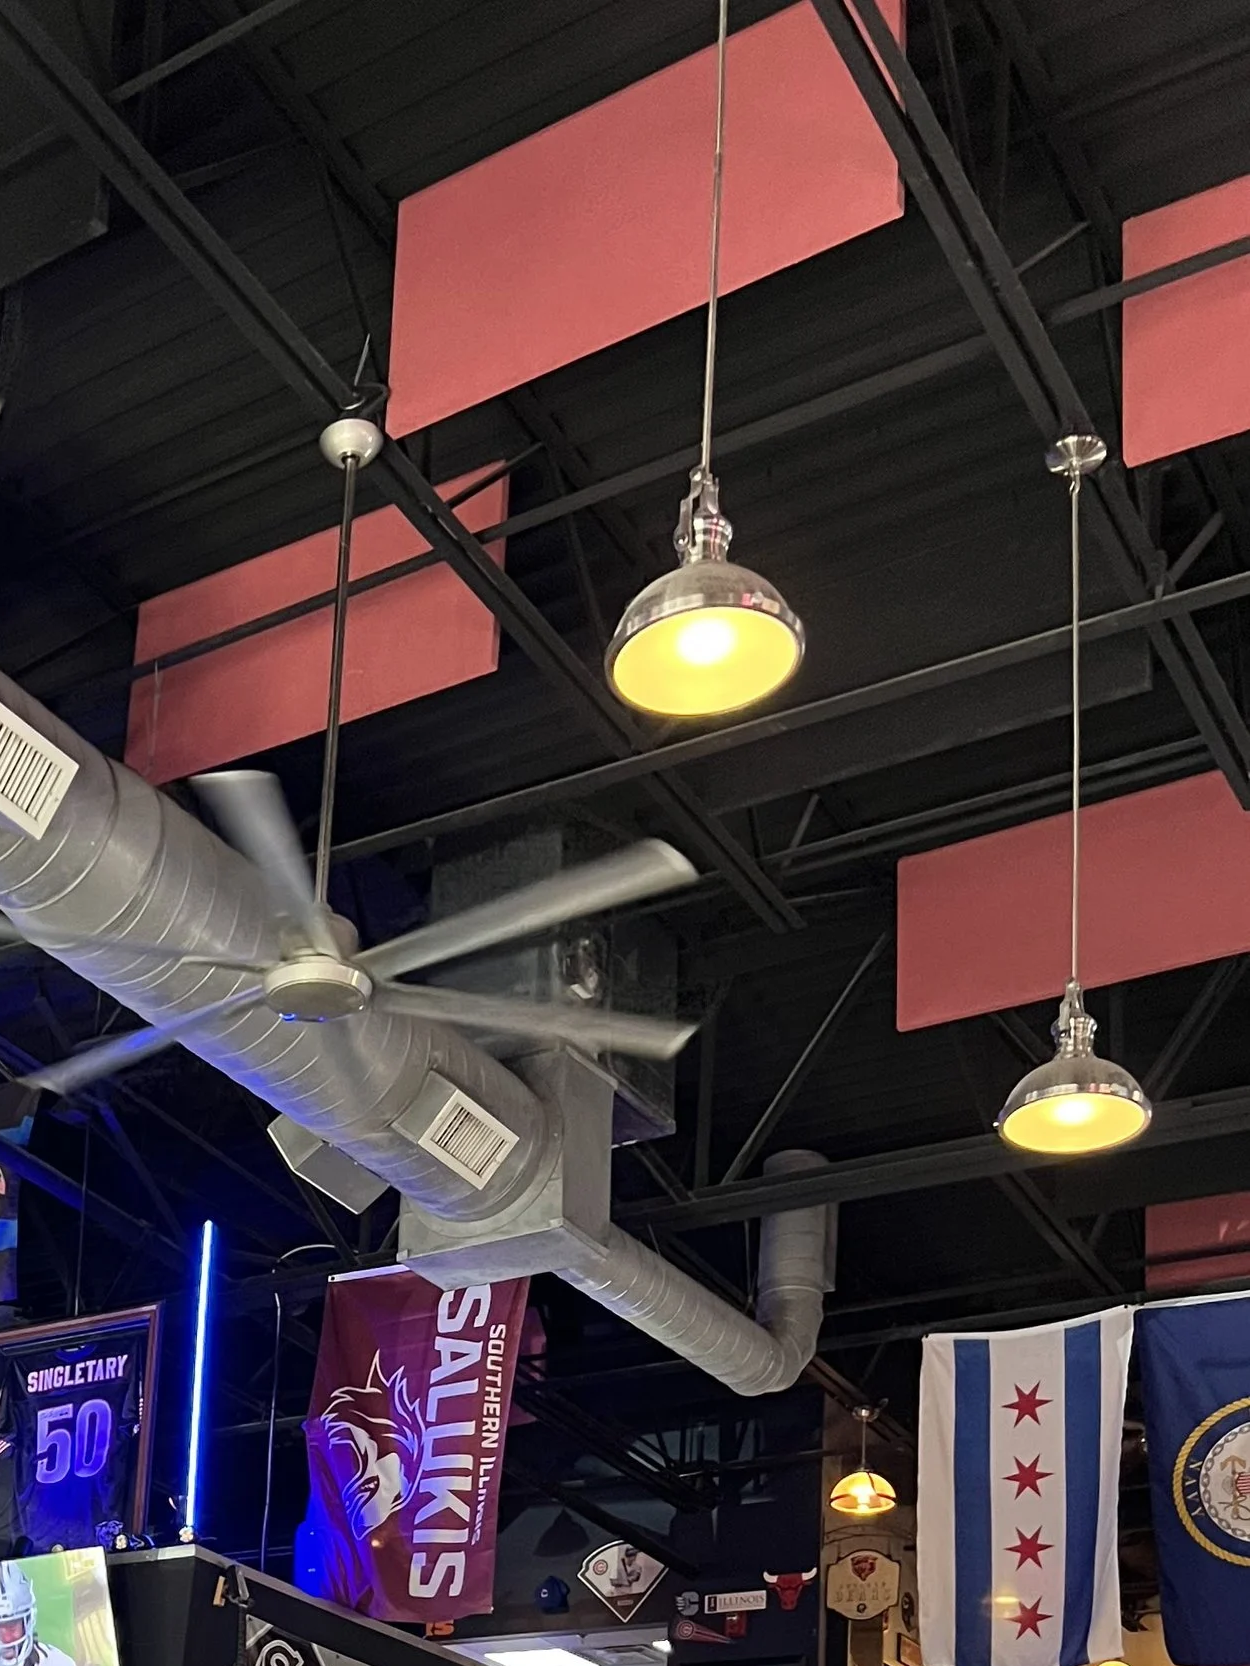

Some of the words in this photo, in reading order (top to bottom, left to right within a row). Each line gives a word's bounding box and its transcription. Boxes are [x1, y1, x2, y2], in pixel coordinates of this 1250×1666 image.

[27, 1355, 128, 1393] SINGLETARY
[481, 1324, 507, 1450] SOUTHERN
[35, 1398, 113, 1485] 50
[408, 1284, 493, 1599] SALUKIS
[718, 1593, 766, 1612] ILLINOIS
